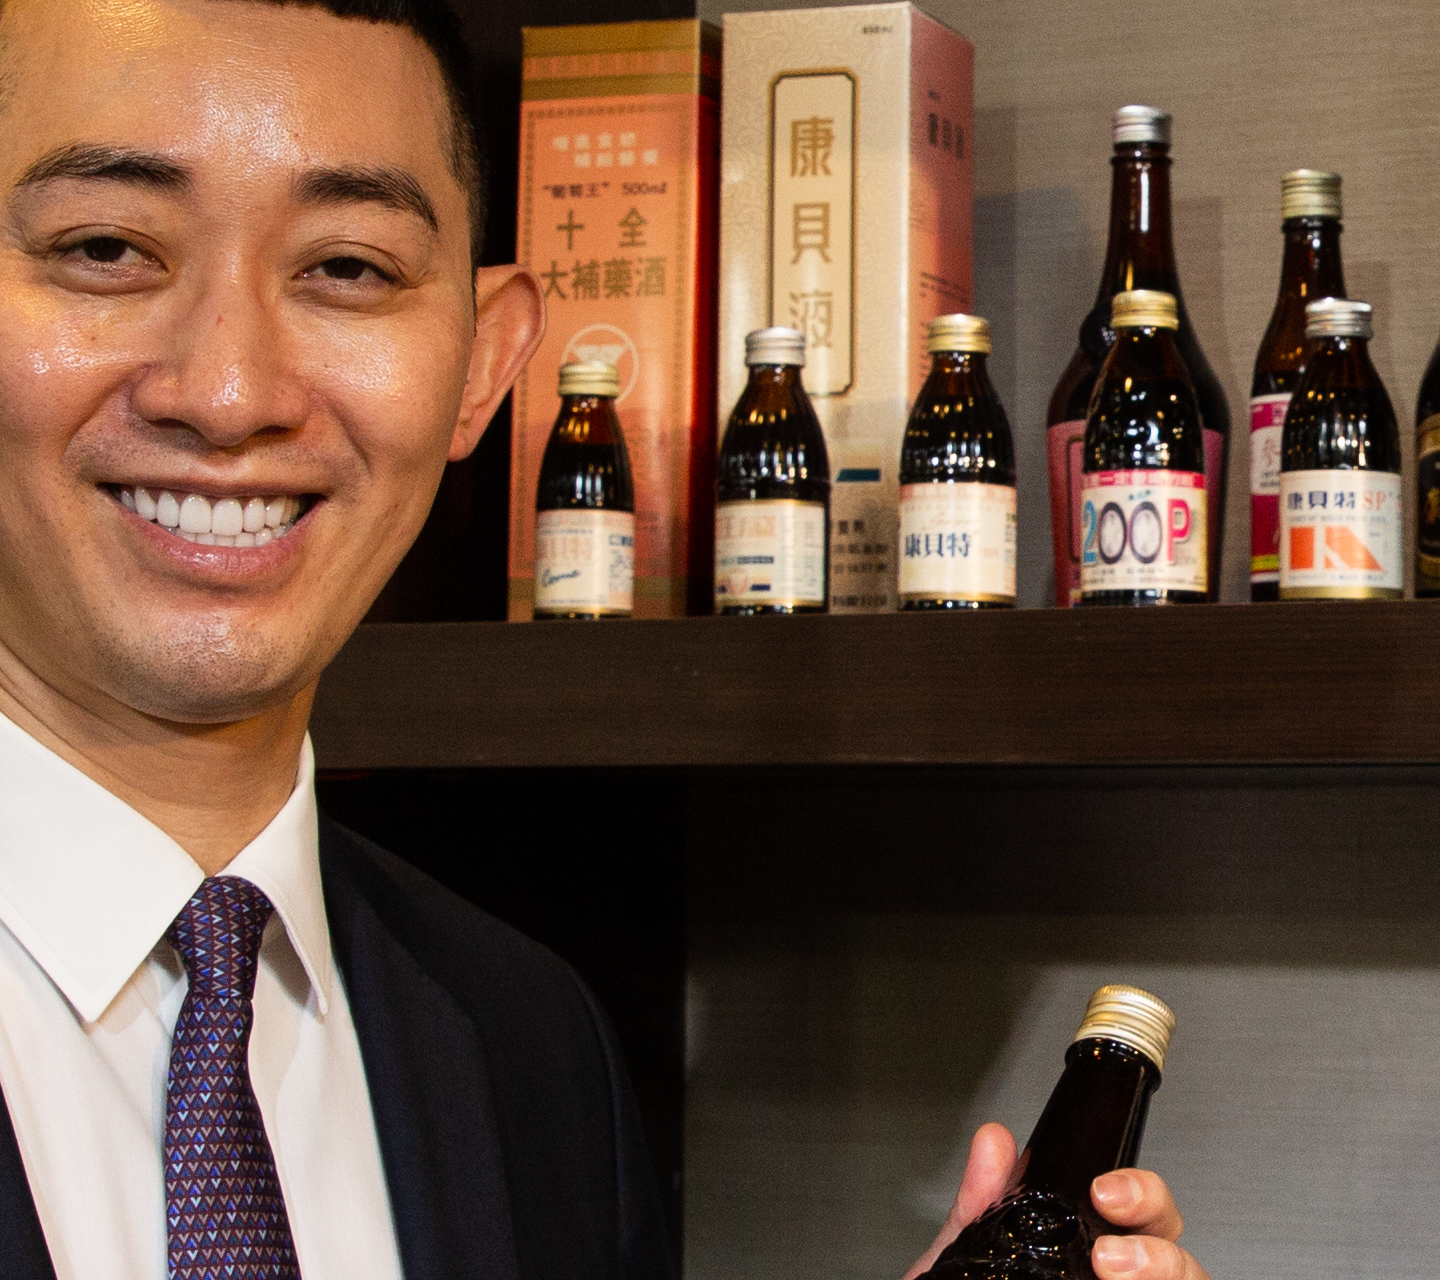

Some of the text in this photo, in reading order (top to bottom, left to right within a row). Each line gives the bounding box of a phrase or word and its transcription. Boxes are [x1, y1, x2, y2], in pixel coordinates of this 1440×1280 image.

[1287, 491, 1356, 510] 康貝特
[904, 532, 972, 559] 康貝特
[1082, 498, 1192, 566] 200P
